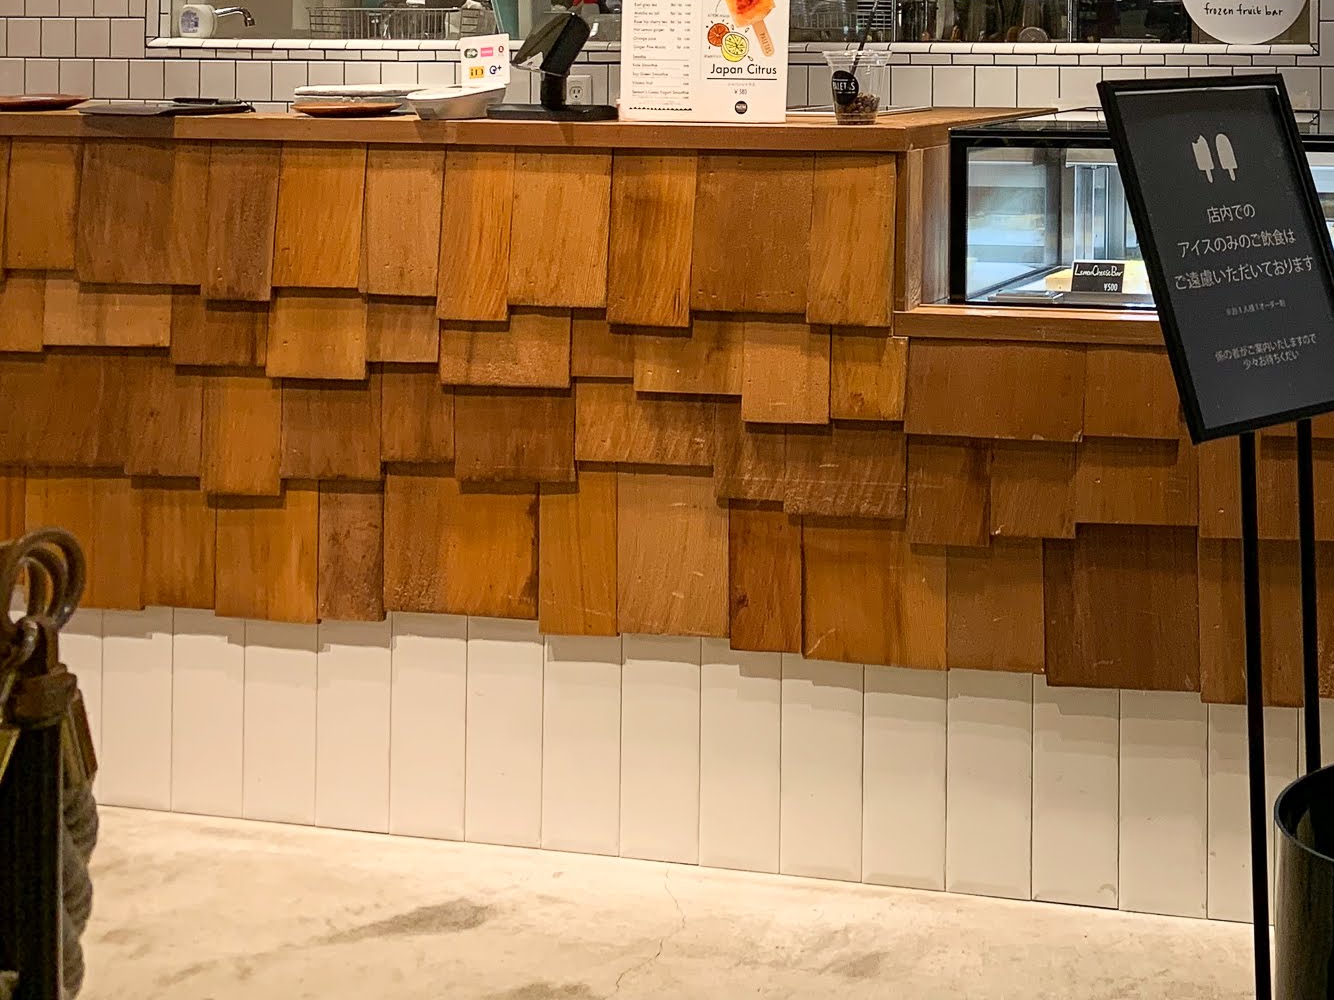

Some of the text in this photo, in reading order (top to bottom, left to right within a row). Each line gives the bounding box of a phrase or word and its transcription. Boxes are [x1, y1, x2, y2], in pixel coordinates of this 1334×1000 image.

[1203, 2, 1283, 16] frozen fruit bar
[710, 63, 777, 77] Japan Citrus
[1207, 203, 1256, 224] 店内での
[1177, 228, 1297, 258] アイスのみのご飲食は
[1174, 254, 1313, 291] ご遠慮いただいております
[1103, 283, 1118, 292] ¥500
